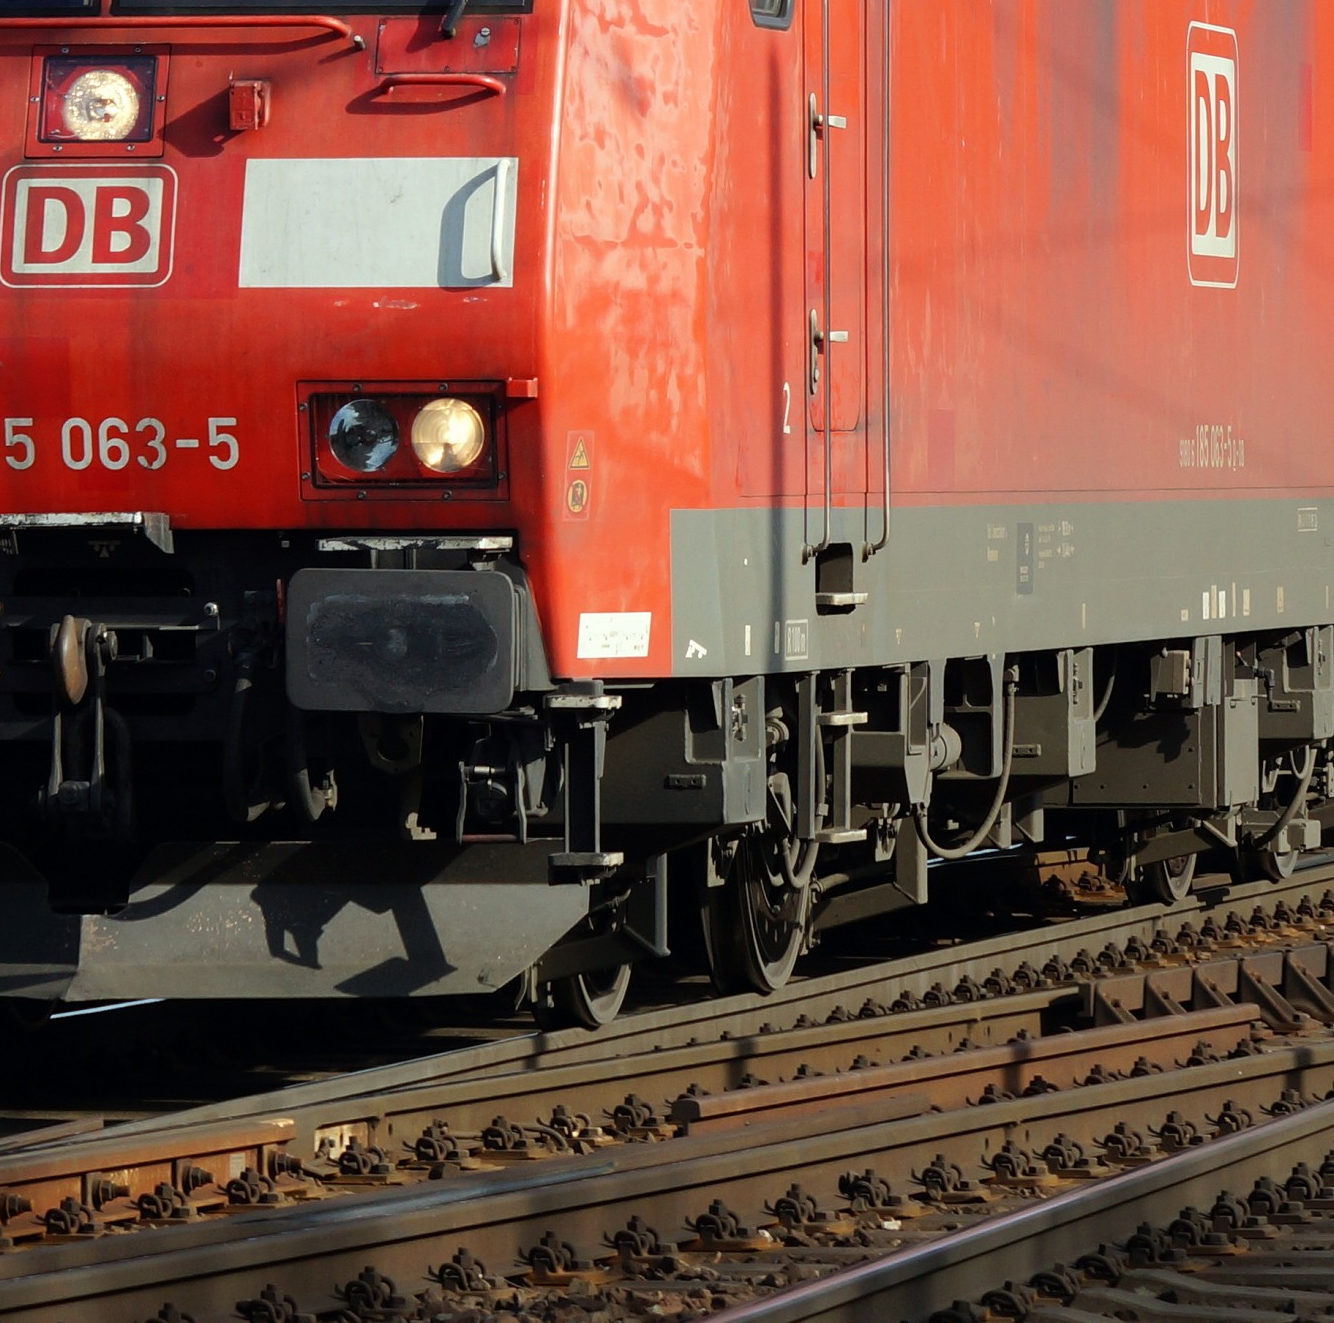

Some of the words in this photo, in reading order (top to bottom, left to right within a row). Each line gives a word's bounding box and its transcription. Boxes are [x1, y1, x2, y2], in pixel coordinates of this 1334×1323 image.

[1195, 69, 1233, 239] DB
[23, 186, 151, 264] DB
[783, 381, 791, 435] 2
[61, 417, 240, 470] 063-5
[1196, 425, 1209, 468] 185
